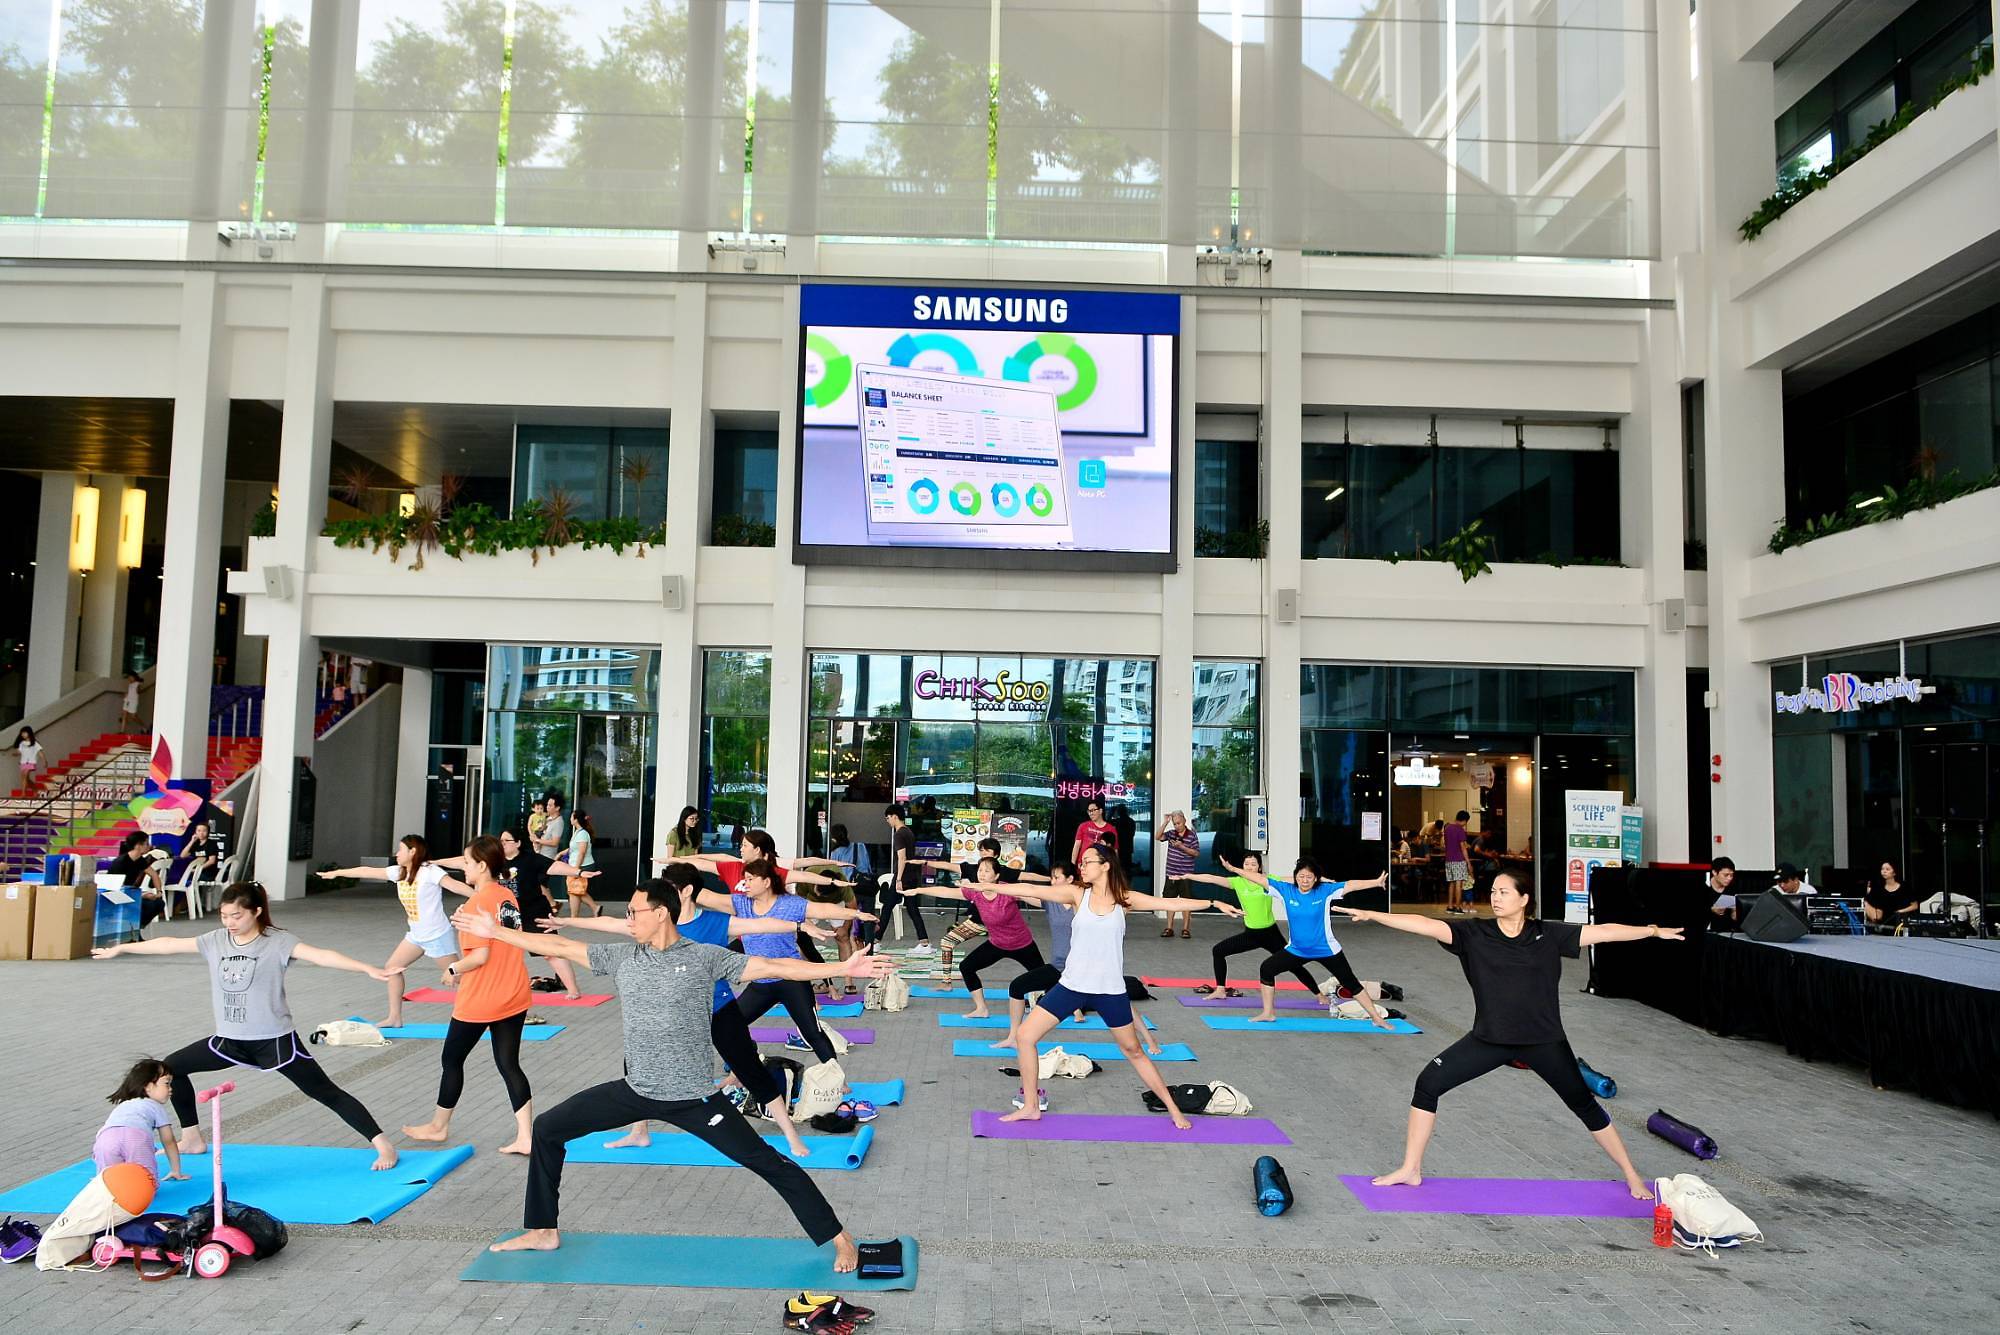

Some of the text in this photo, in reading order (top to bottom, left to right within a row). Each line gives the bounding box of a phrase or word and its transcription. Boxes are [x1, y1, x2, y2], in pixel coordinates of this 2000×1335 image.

[913, 295, 1068, 323] SAMSUNG
[891, 390, 943, 402] BALANCE SHEET
[971, 701, 1048, 713] Korean Kitchen
[1056, 780, 1125, 800] 안녕하세요
[1572, 804, 1599, 812] SCREEN
[1584, 812, 1605, 821] LIFE
